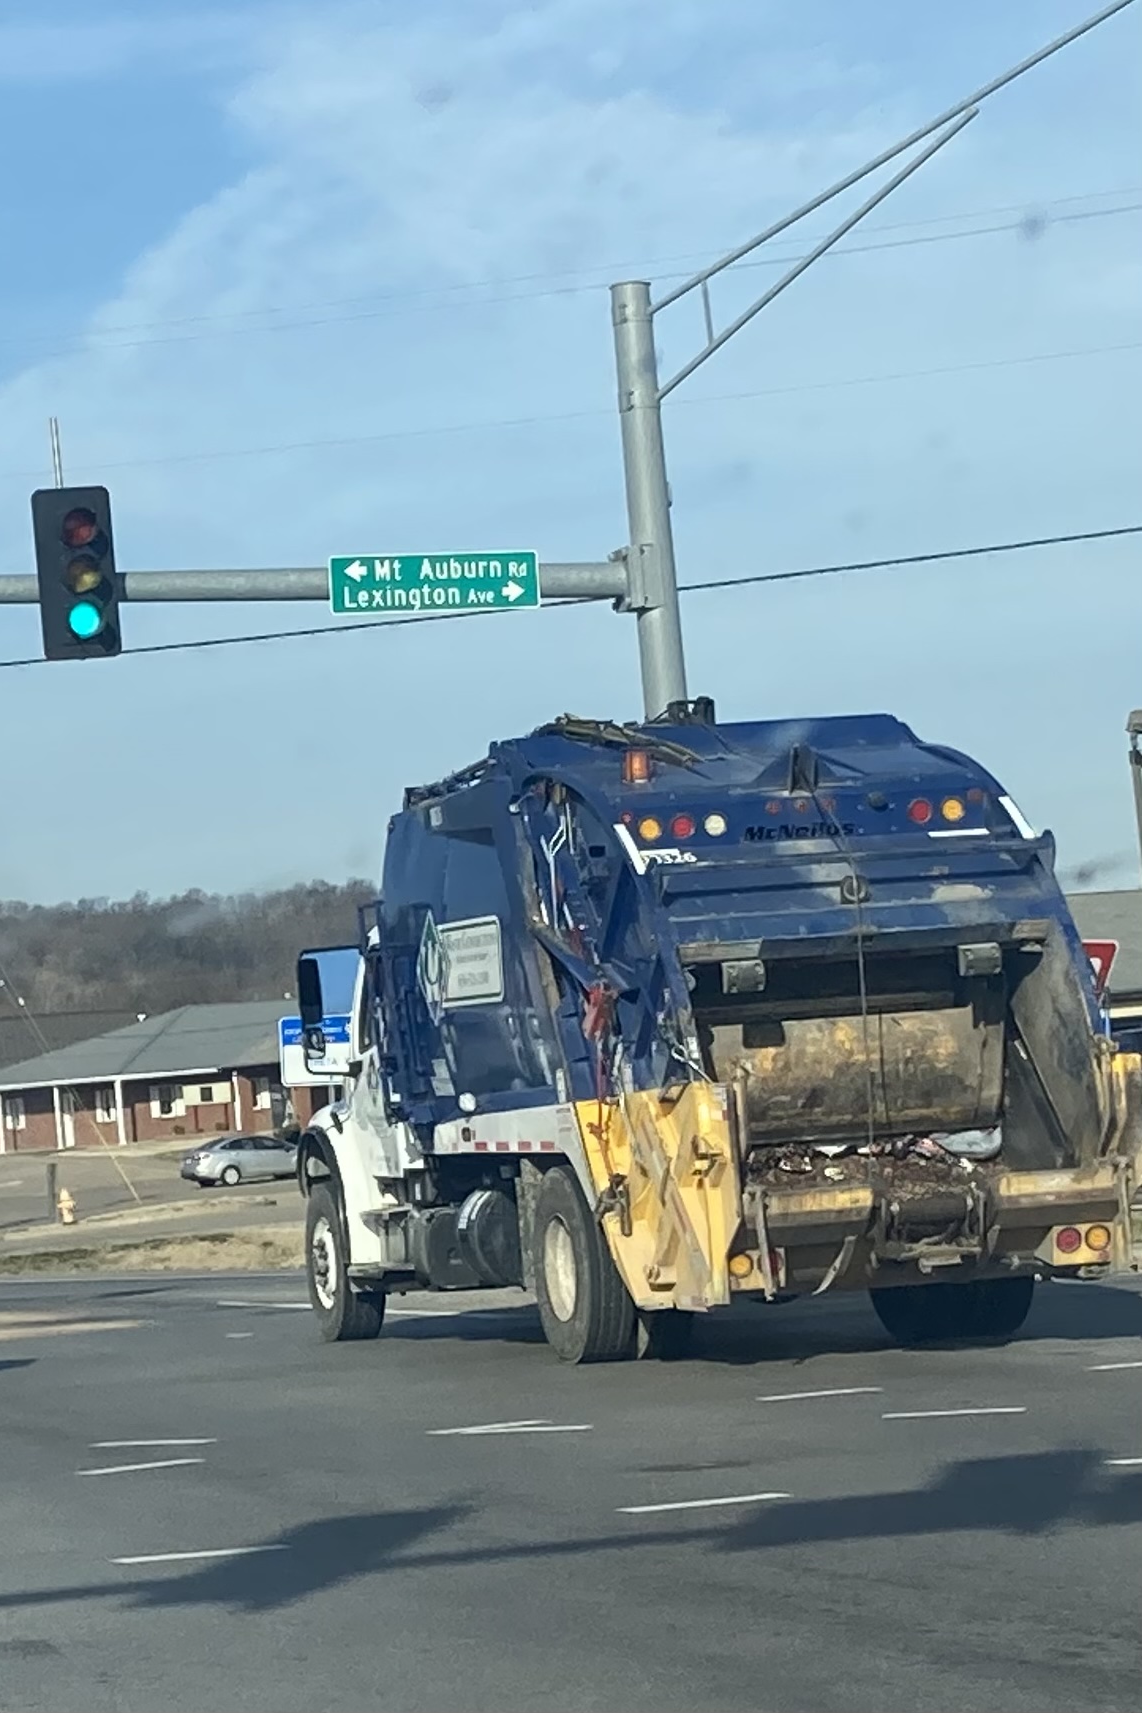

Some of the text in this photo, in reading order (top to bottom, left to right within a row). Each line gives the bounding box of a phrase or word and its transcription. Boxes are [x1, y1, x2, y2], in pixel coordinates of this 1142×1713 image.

[374, 557, 527, 581] Mt Auburn Rd
[343, 584, 495, 611] Lexington Ave
